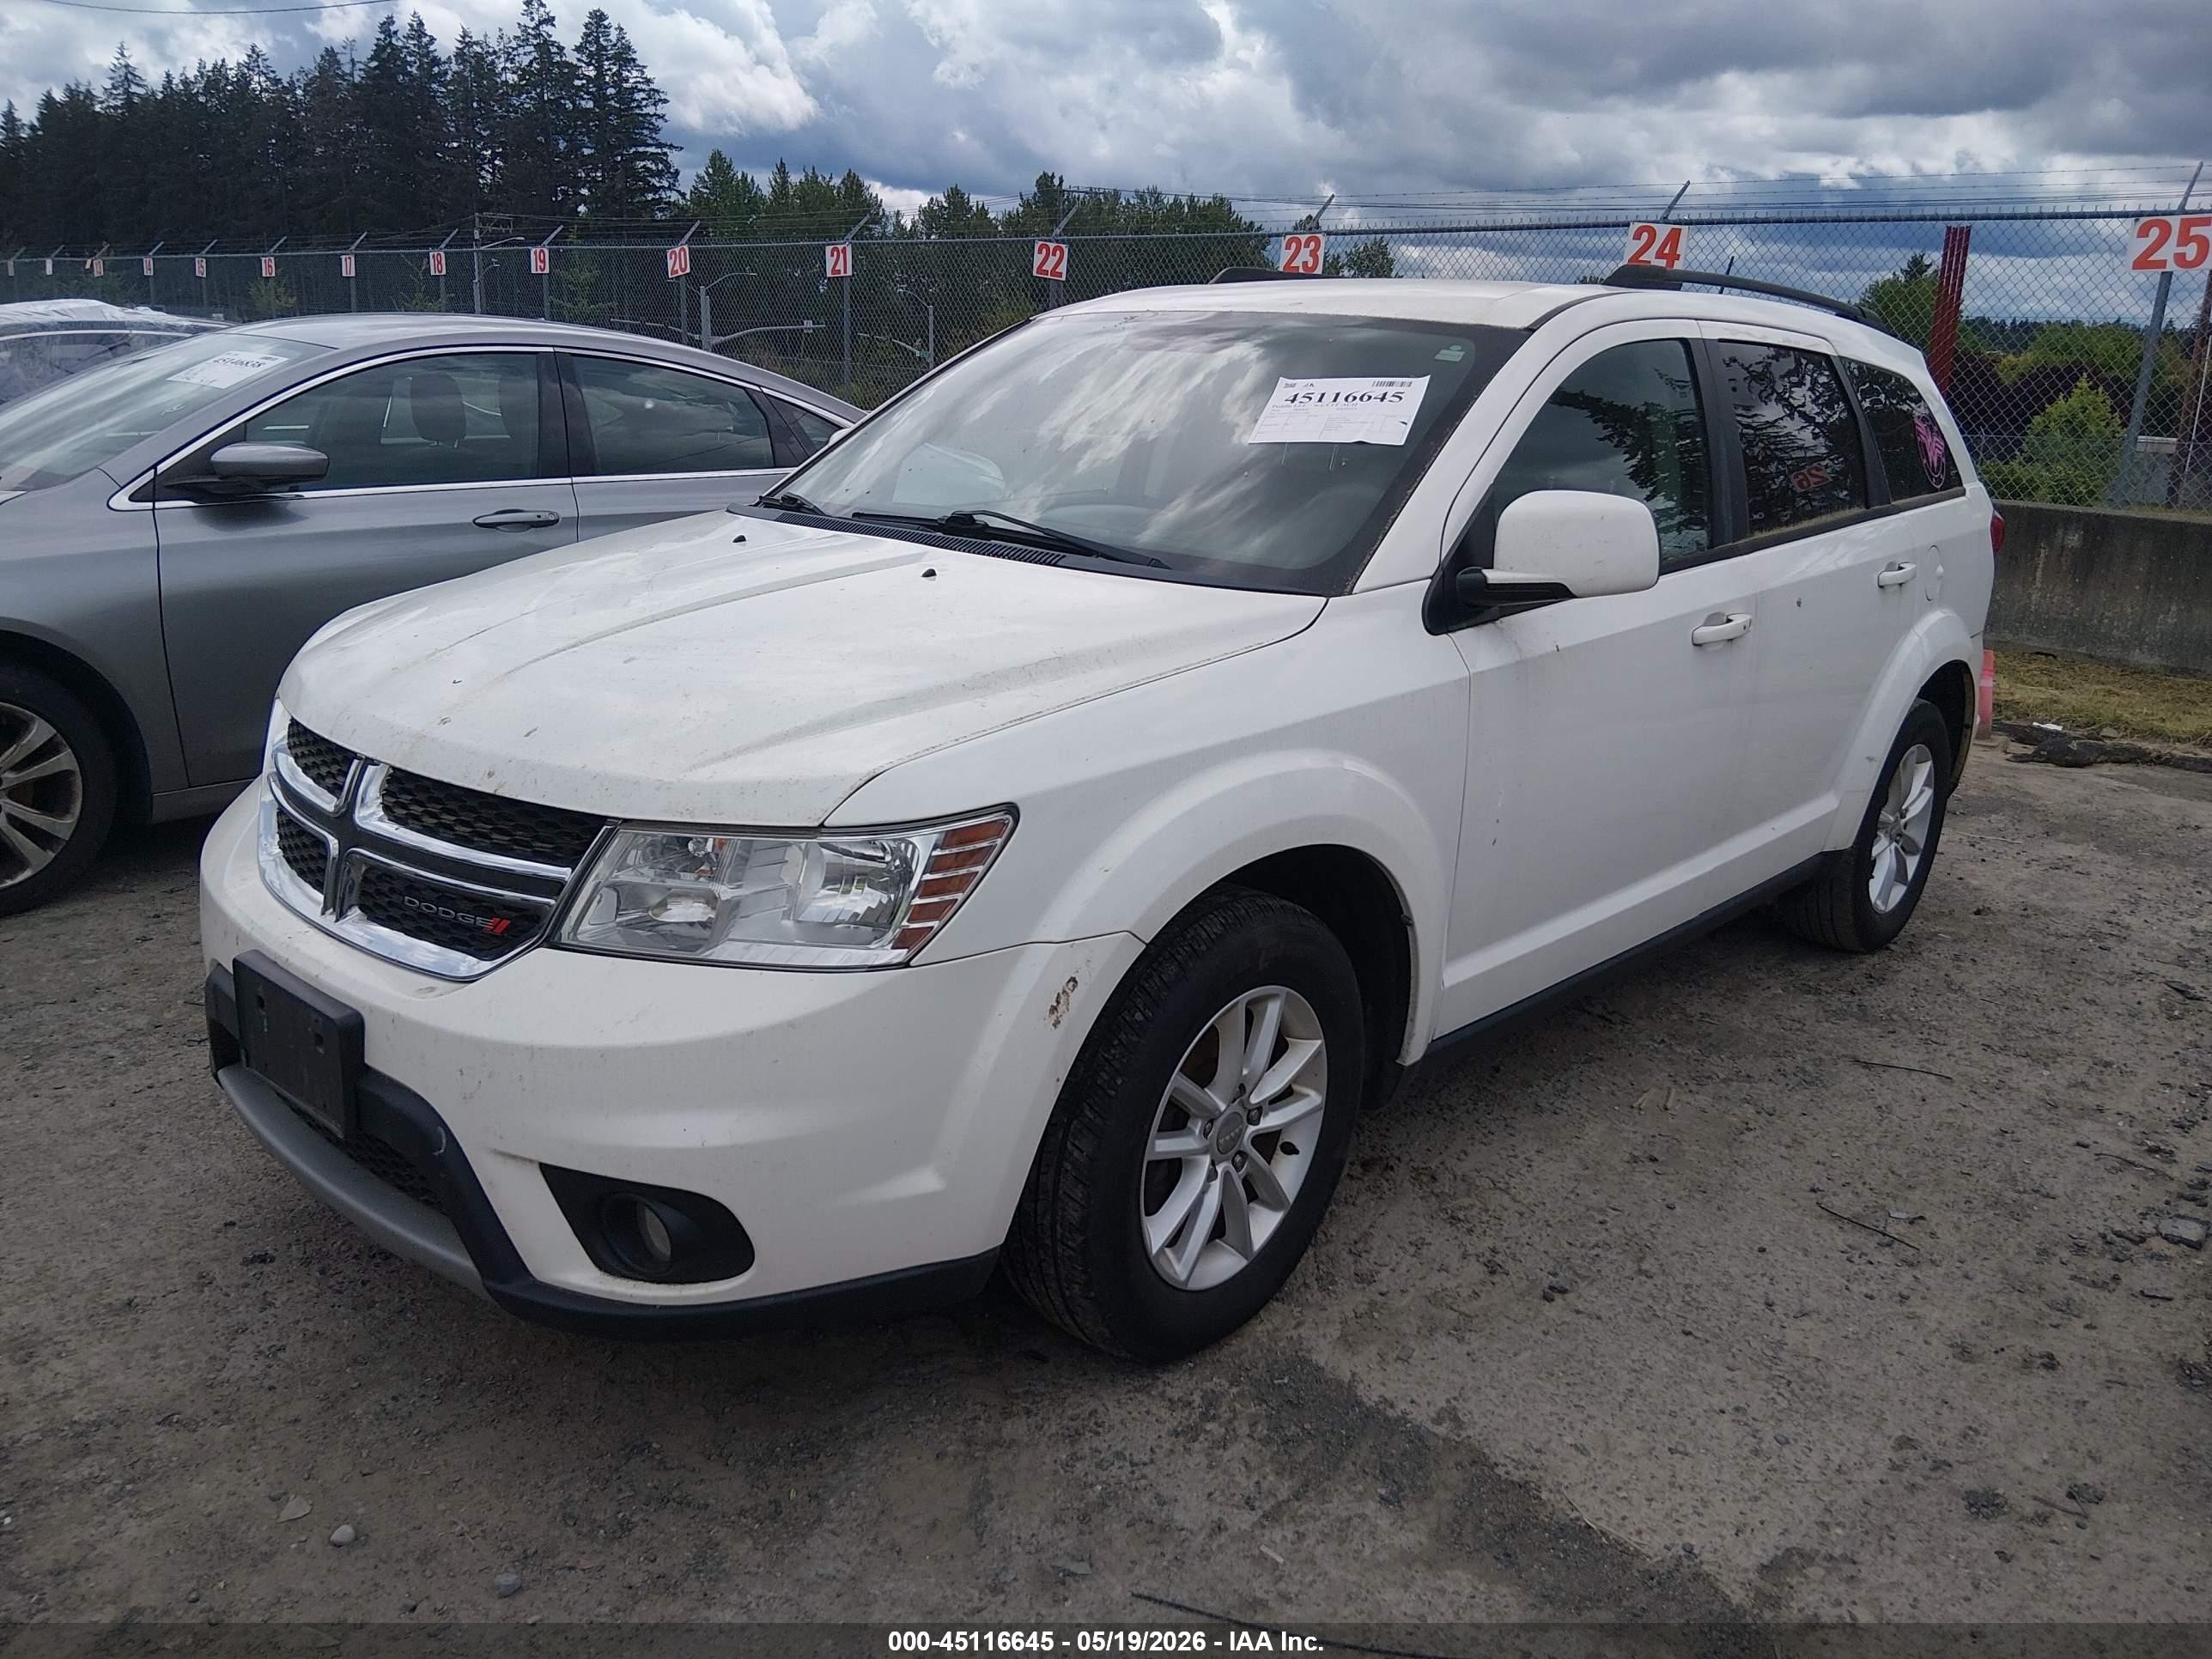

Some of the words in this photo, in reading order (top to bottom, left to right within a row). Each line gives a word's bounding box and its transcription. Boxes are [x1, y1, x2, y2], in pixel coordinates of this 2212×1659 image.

[1283, 235, 1322, 273] 23
[1627, 225, 1682, 269] 24
[2131, 216, 2212, 270] 25
[198, 258, 205, 276] 15
[264, 258, 273, 276] 16
[344, 257, 352, 276] 17
[432, 252, 443, 274] 18
[533, 249, 546, 272] 19
[669, 246, 688, 276] 20
[830, 246, 848, 275] 21
[1036, 243, 1065, 278] 22
[1285, 391, 1406, 404] 45116645
[404, 896, 494, 931] DODGE
